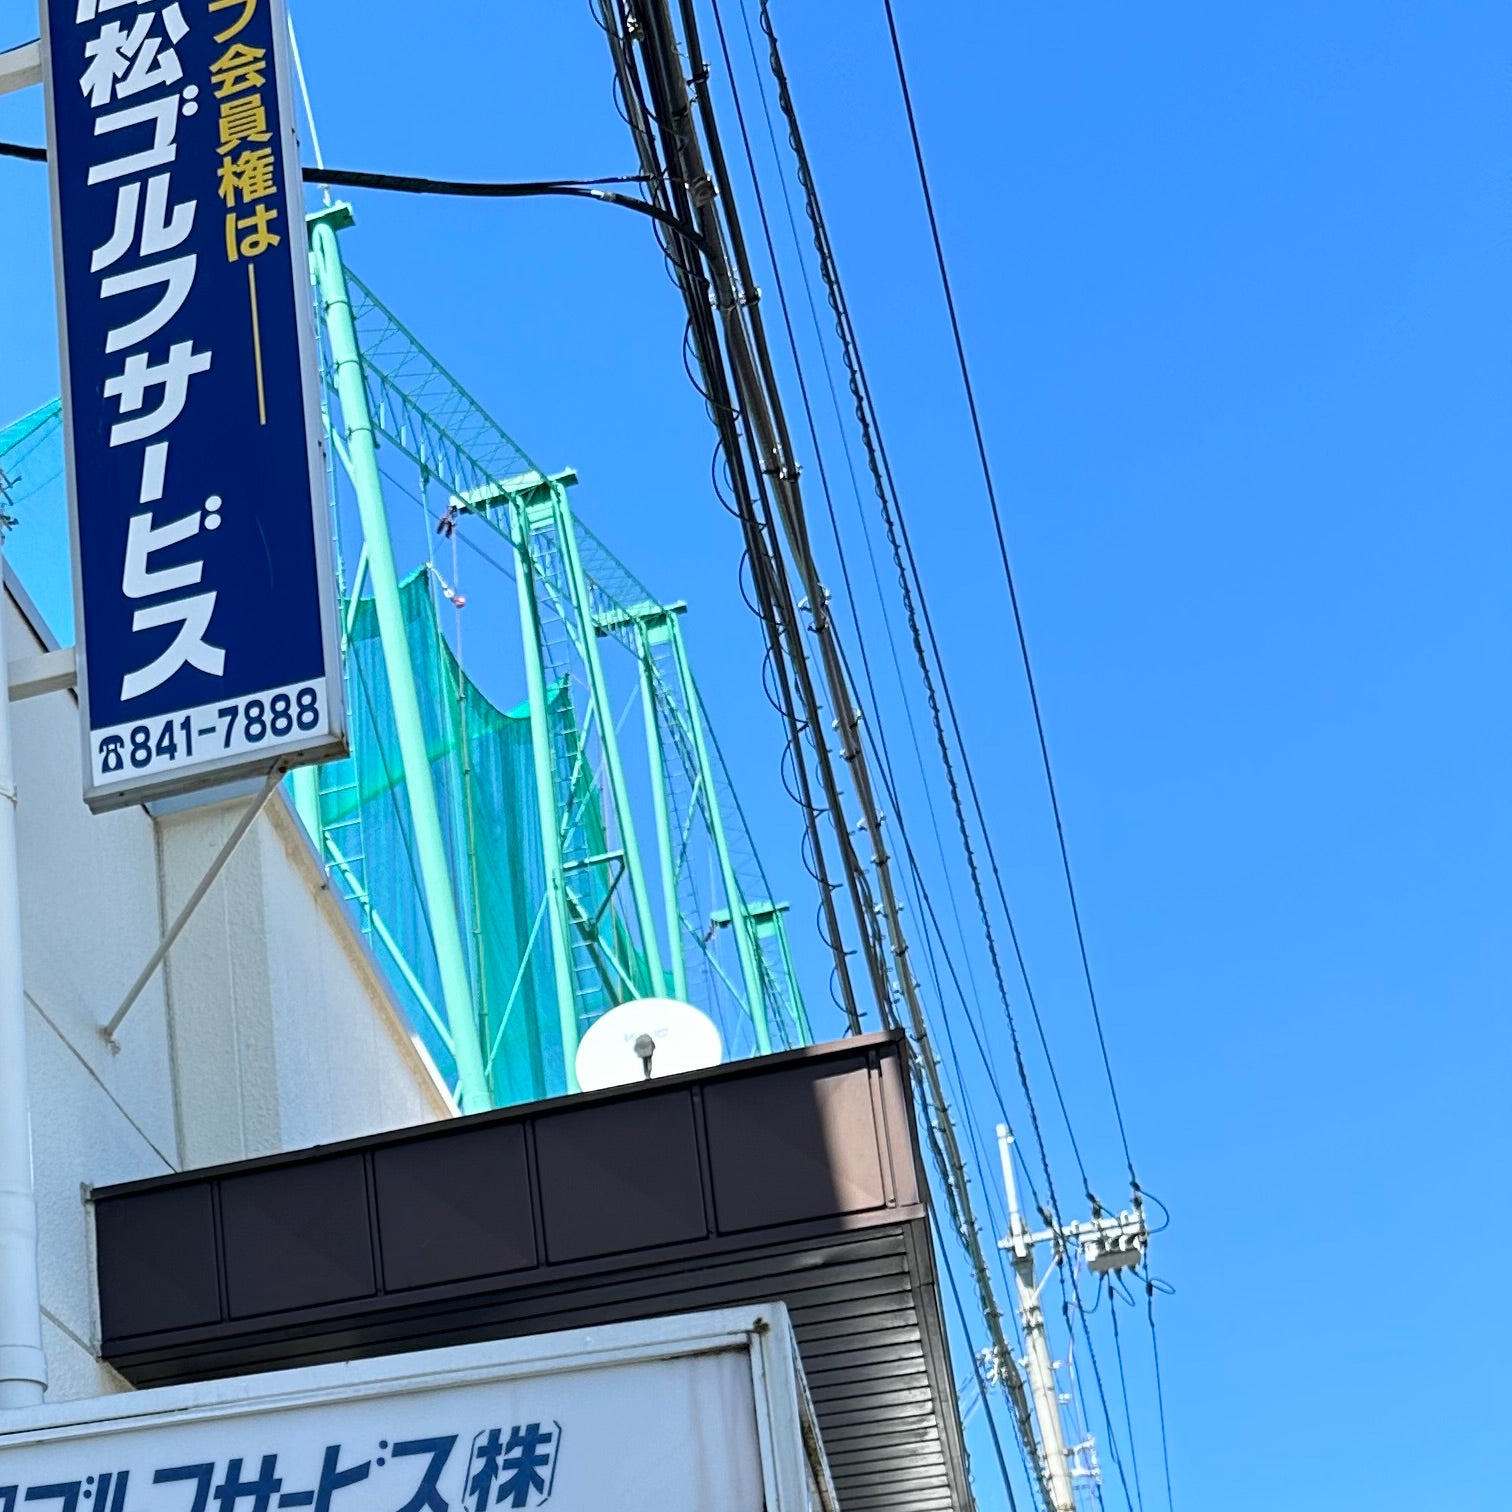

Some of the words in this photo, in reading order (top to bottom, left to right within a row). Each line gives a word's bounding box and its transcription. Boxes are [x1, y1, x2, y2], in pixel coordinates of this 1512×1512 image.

[75, 0, 225, 701] 松ゴルフサービス
[130, 687, 320, 769] 841-7888
